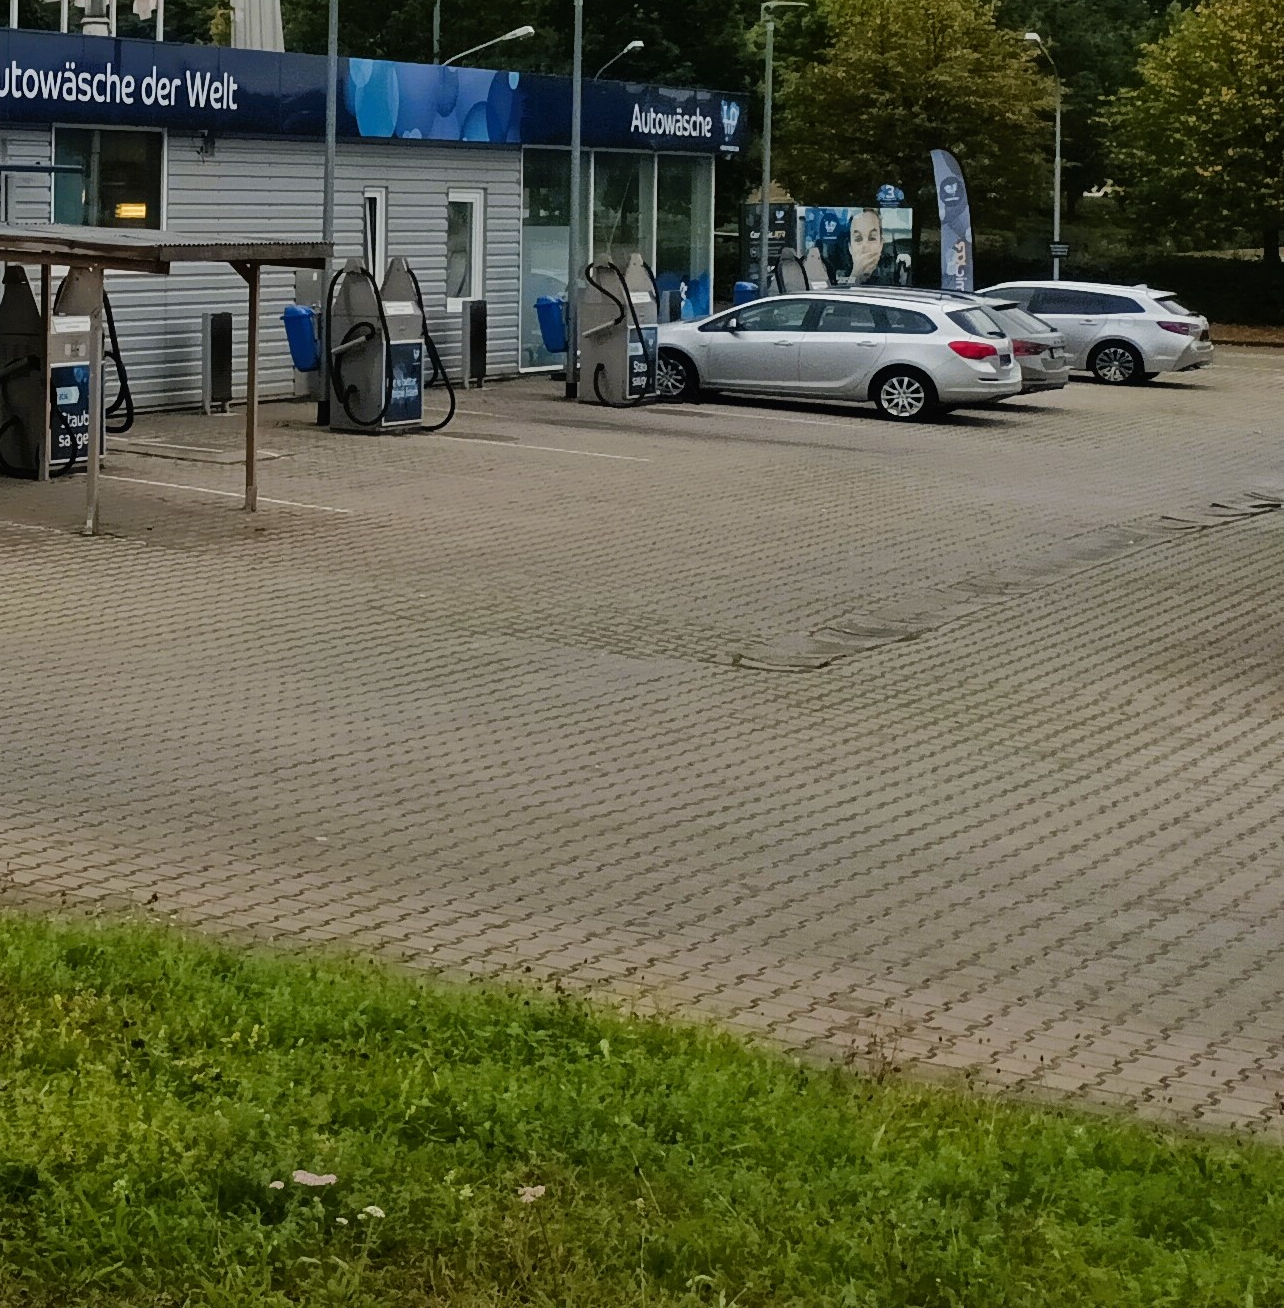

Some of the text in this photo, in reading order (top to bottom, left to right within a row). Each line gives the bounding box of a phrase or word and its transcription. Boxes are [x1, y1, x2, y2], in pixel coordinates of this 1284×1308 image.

[141, 65, 181, 106] der
[186, 70, 238, 110] Welt
[630, 103, 712, 137] Autowäsche
